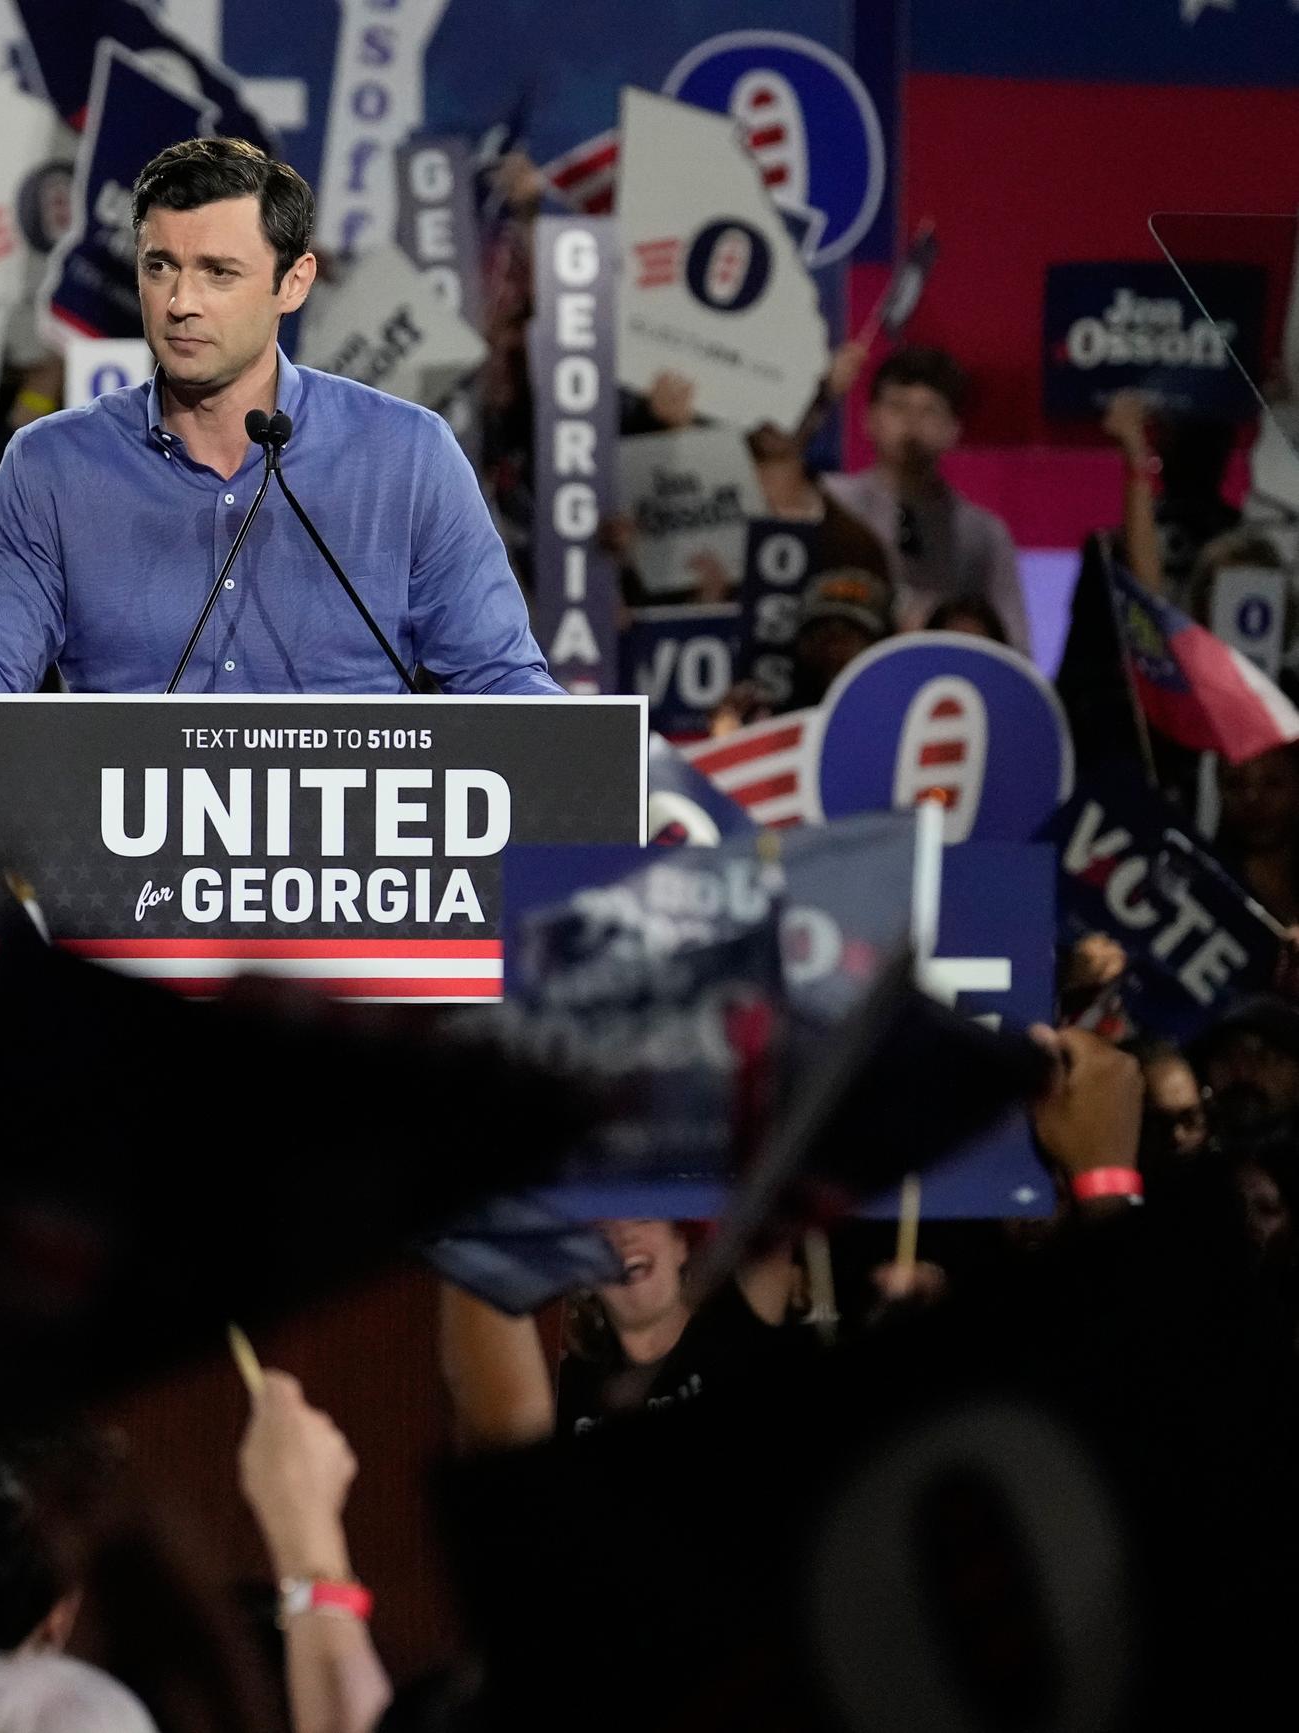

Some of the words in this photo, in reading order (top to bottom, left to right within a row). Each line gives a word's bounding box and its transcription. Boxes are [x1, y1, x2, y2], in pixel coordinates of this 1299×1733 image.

[1065, 316, 1239, 372] Ossoff
[550, 228, 601, 666] GEORGIA
[182, 729, 237, 748] TEXT
[244, 729, 327, 748] UNITED
[334, 729, 362, 748] TO
[367, 729, 432, 748] 51015
[101, 768, 511, 856] UNITED
[135, 880, 174, 922] for
[182, 868, 486, 923] GEORGIA
